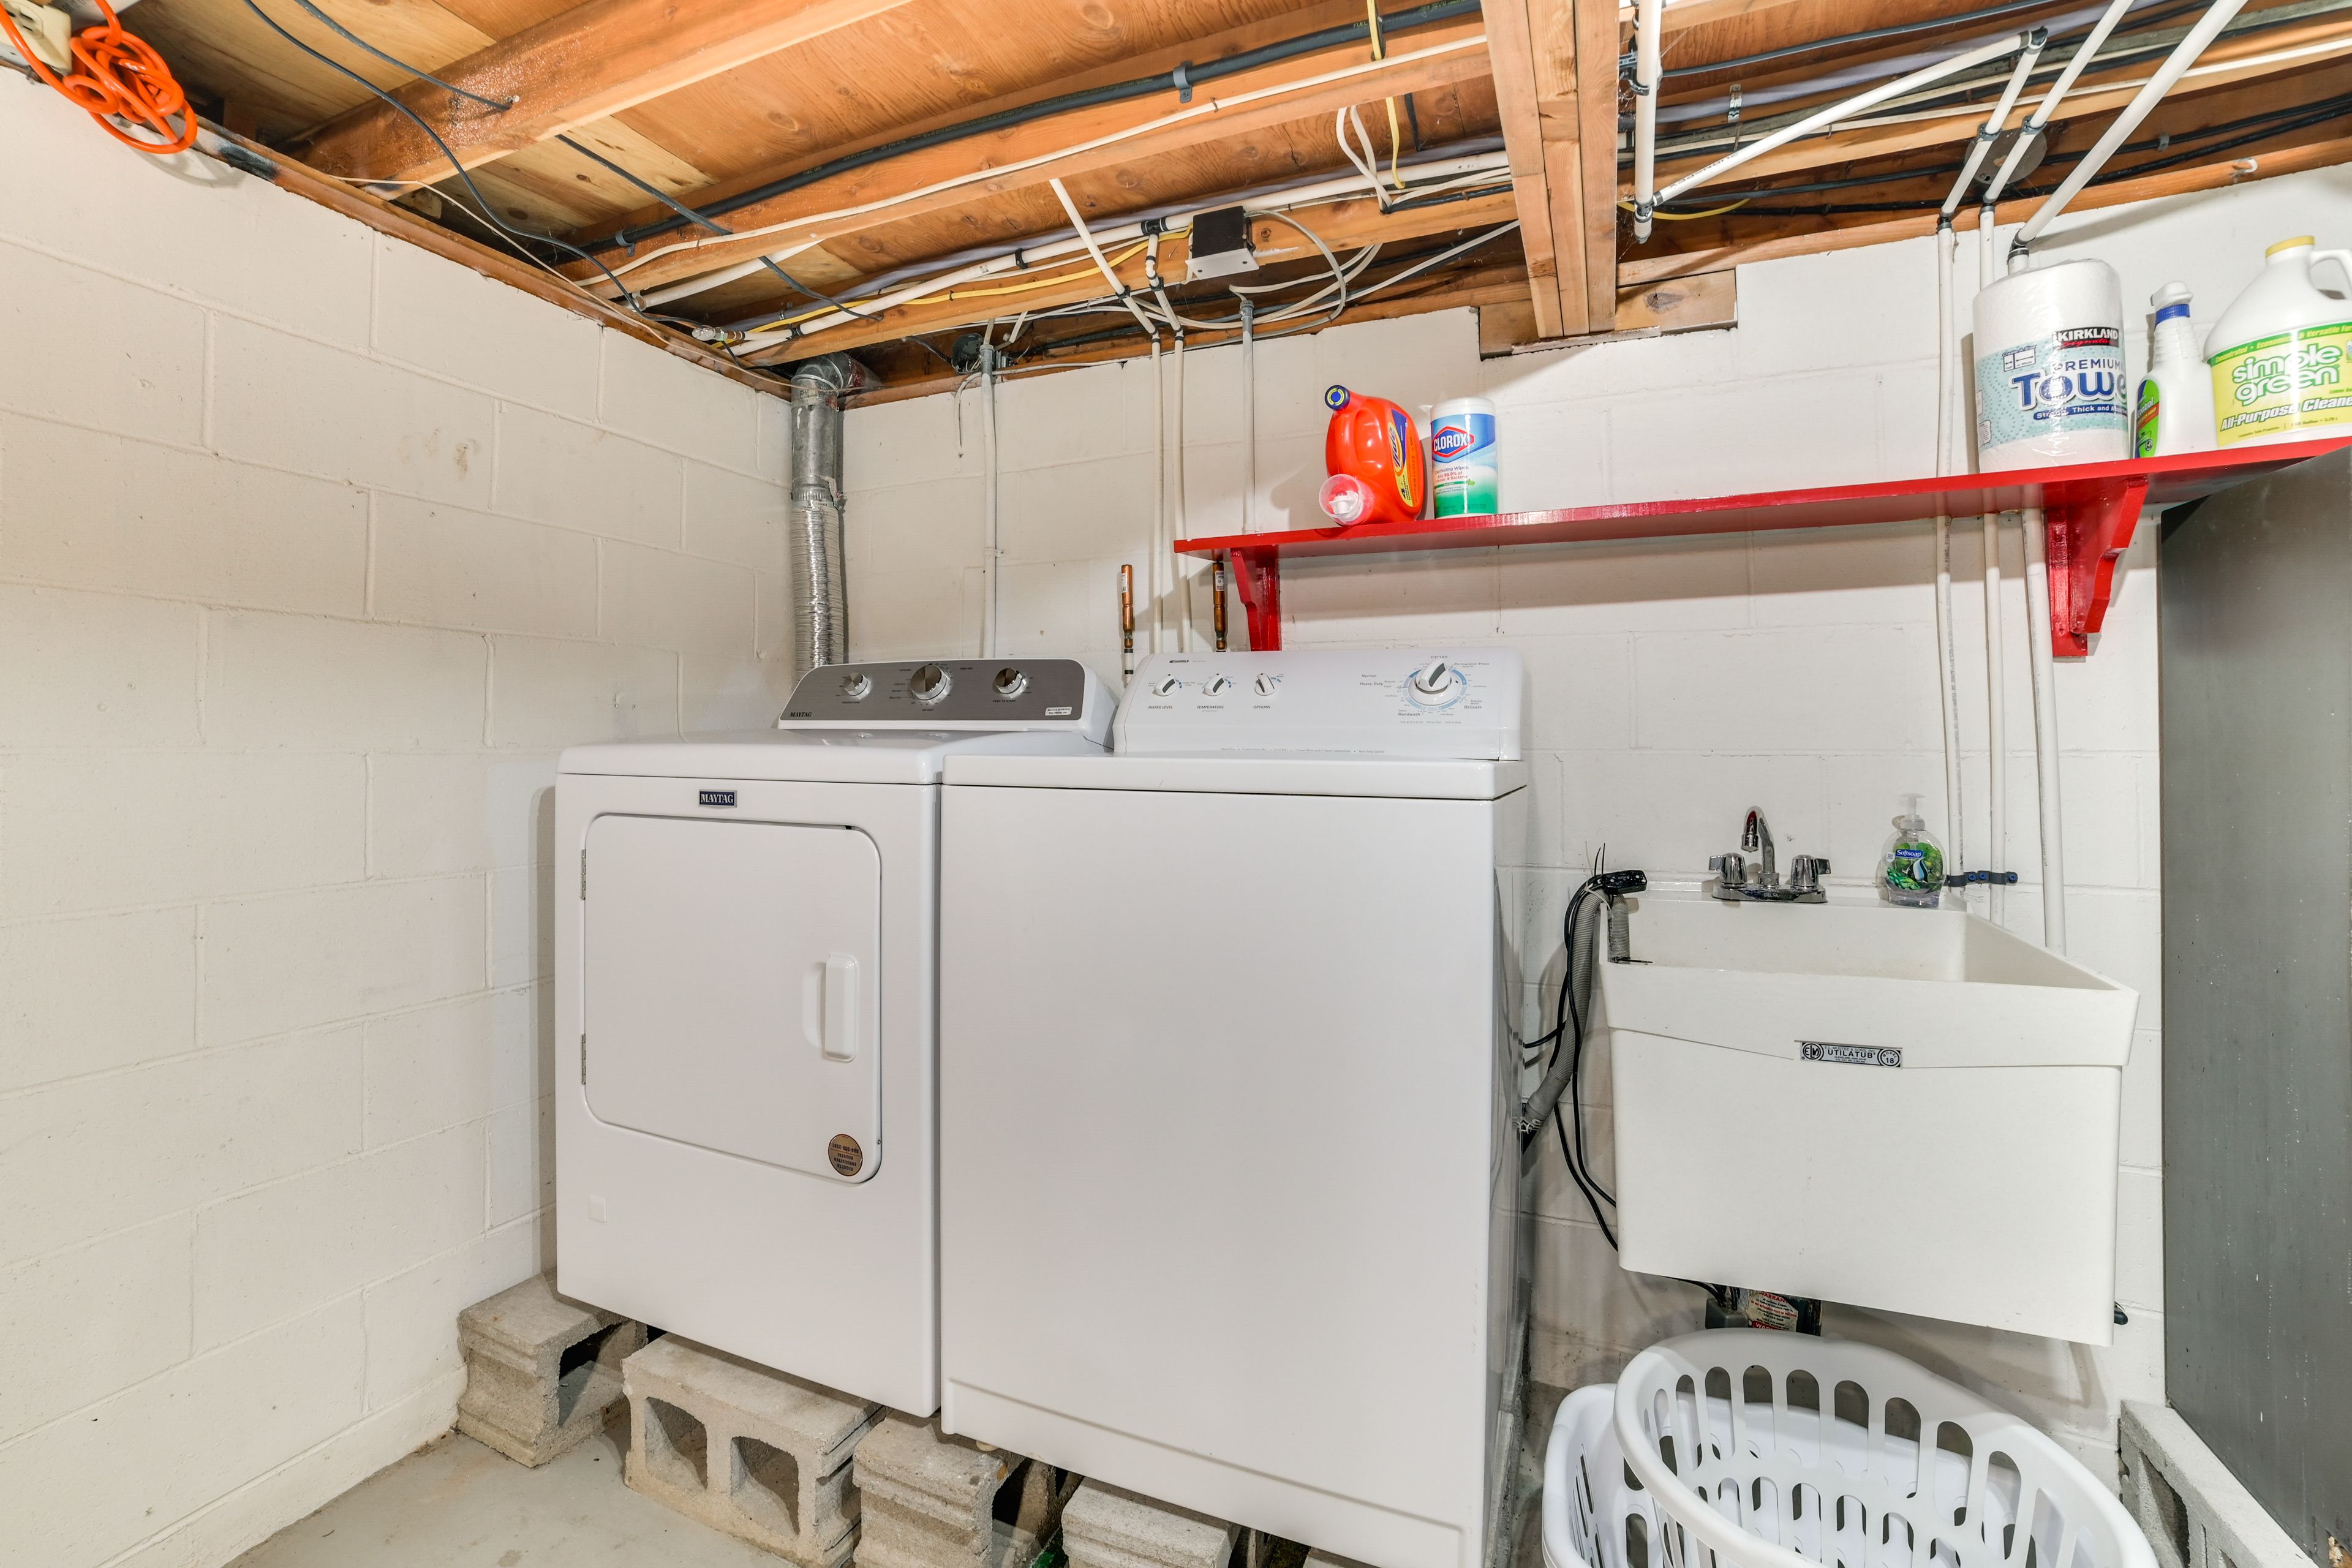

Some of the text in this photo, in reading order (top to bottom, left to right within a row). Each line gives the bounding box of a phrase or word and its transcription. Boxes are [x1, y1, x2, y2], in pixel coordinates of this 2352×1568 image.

[2058, 328, 2119, 342] KIRKLAND
[2232, 342, 2343, 384] simple
[2234, 366, 2341, 407] green
[2072, 405, 2095, 413] Thick
[2220, 402, 2301, 432] All-Purpose
[1433, 433, 1468, 452] CLOROX
[700, 793, 734, 804] MAYTAG
[1896, 849, 1921, 858] Softsoap
[1827, 1049, 1873, 1059] UTILATUB
